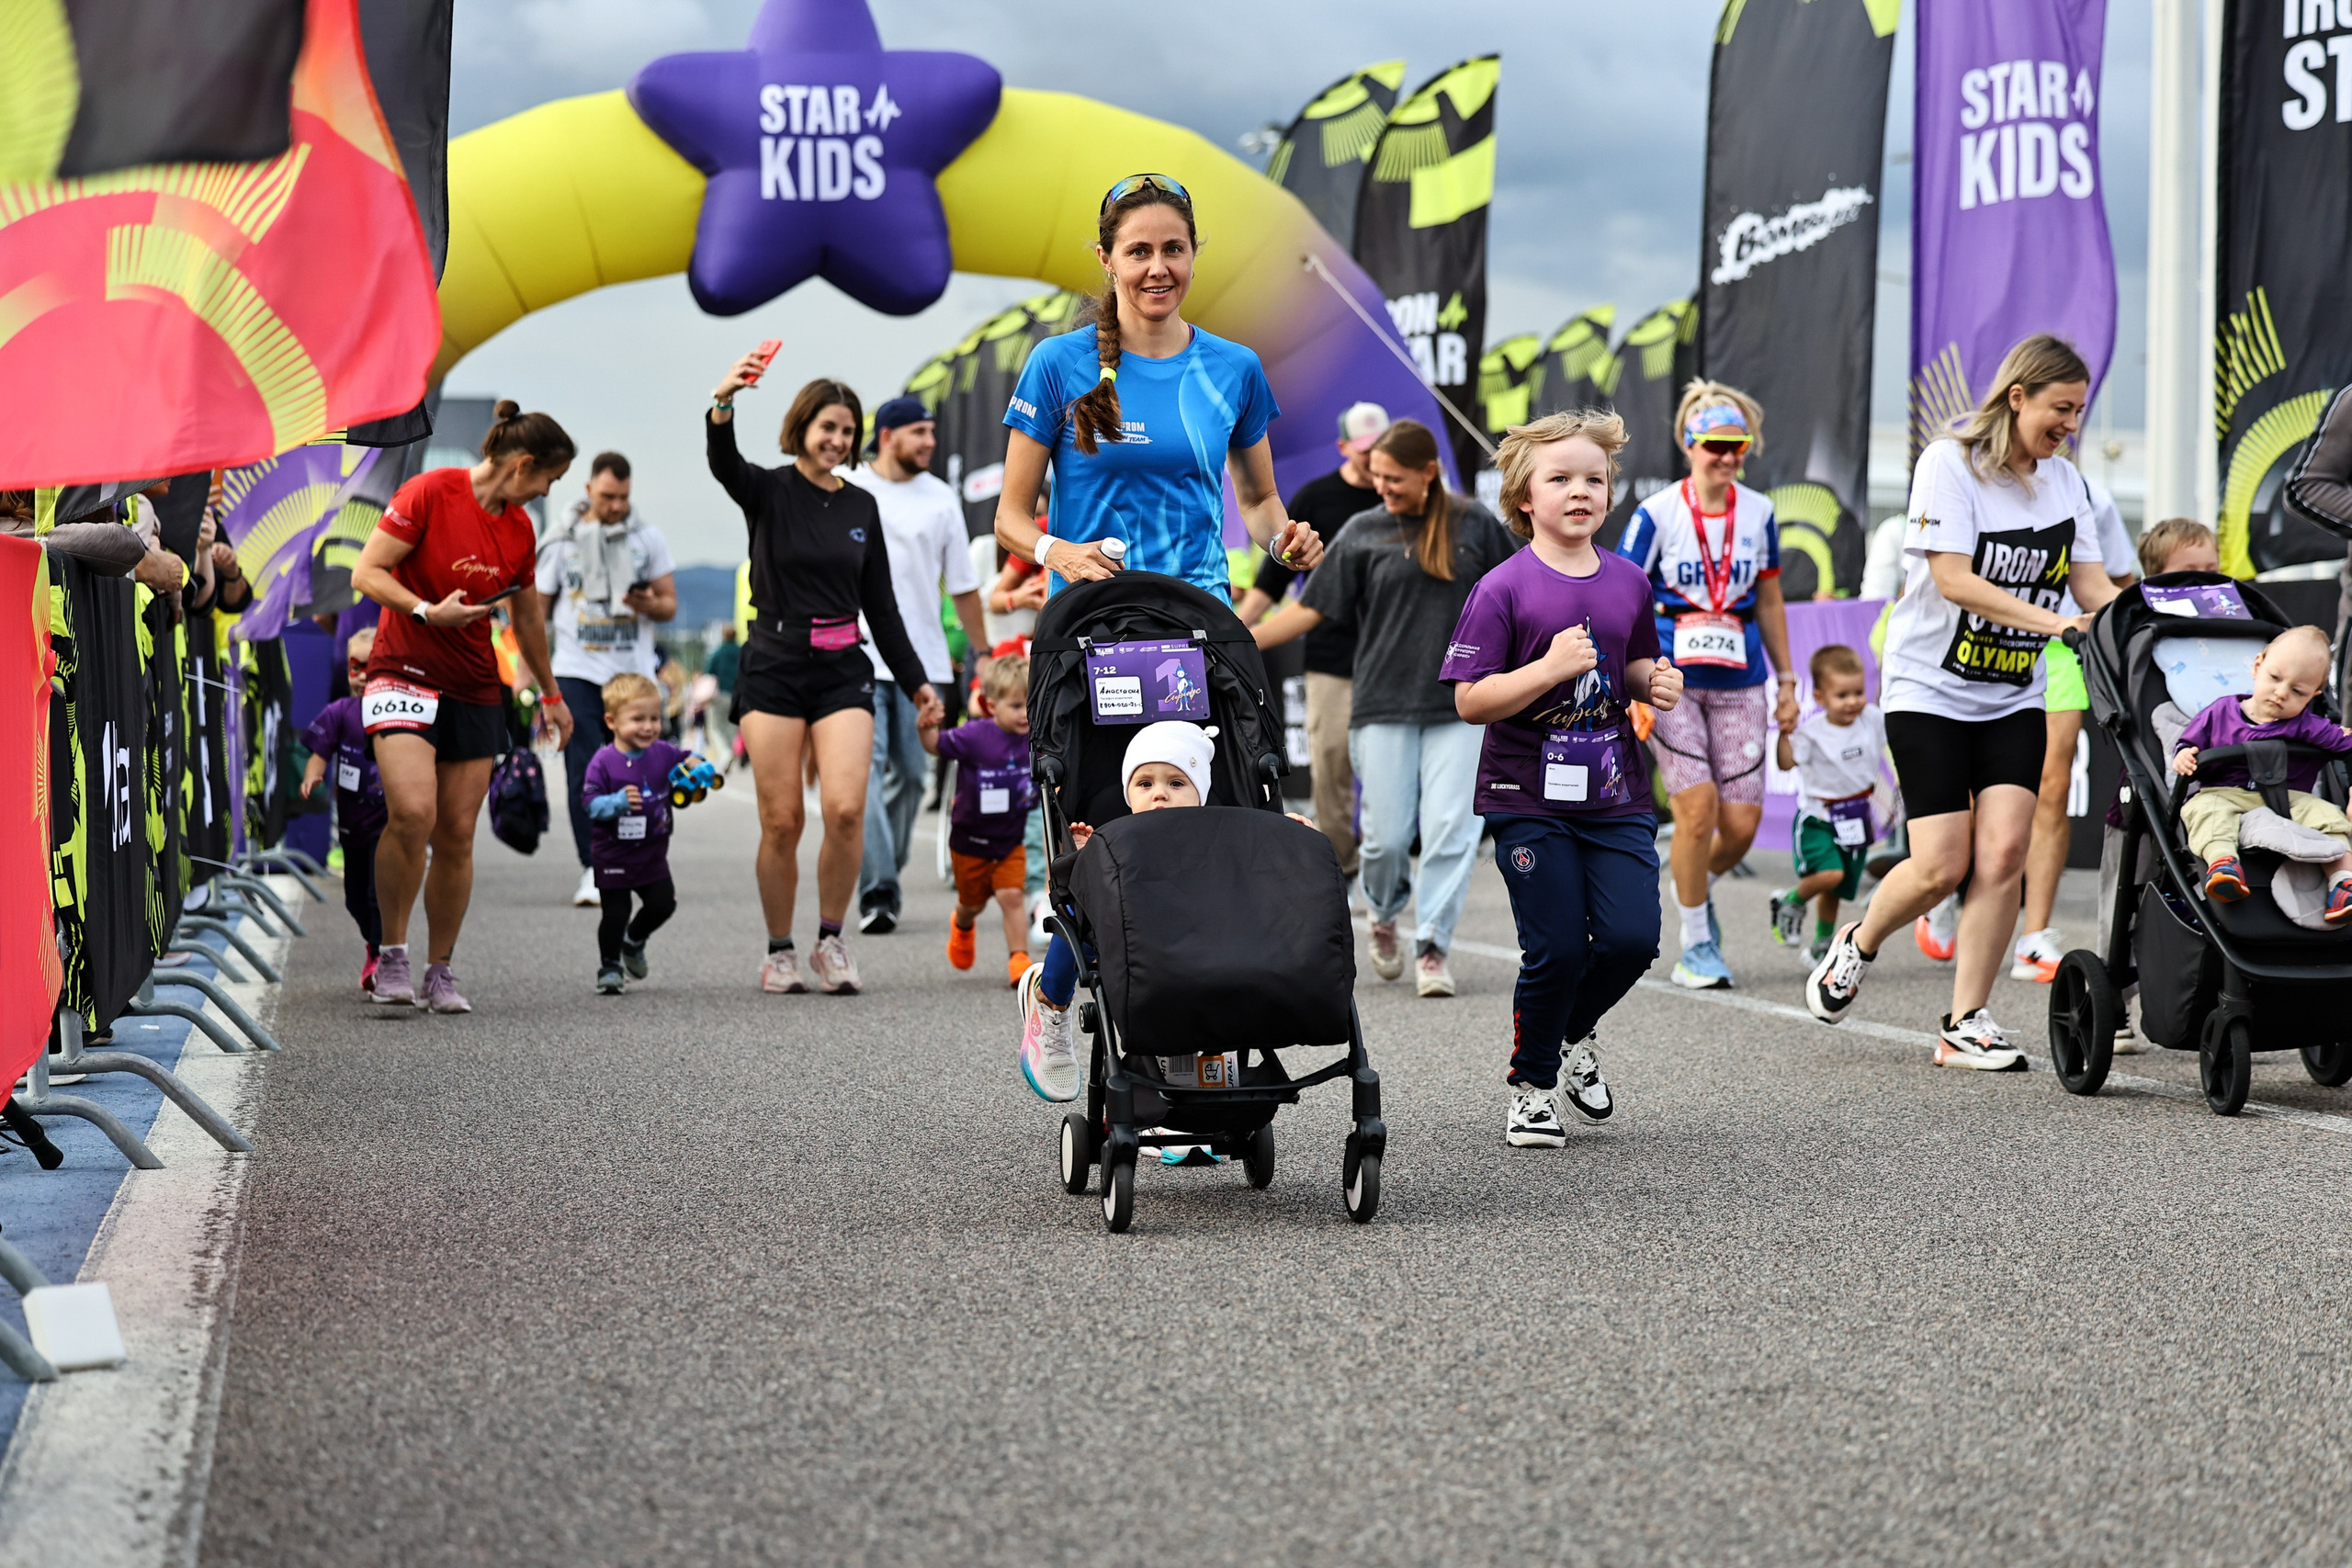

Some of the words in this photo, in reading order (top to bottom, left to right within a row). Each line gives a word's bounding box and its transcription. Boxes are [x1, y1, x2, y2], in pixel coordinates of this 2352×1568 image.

[1961, 59, 2069, 130] STAR
[2282, 34, 2352, 130] ST
[760, 84, 862, 135] STAR
[760, 134, 886, 201] KIDS
[1959, 120, 2095, 211] KIDS
[1980, 540, 2049, 583] IRON
[1688, 635, 1736, 653] 6274
[1957, 640, 2037, 673] OLYMPI
[1093, 666, 1117, 675] 7-12
[372, 699, 424, 716] 6616
[1546, 752, 1565, 761] 0-6
